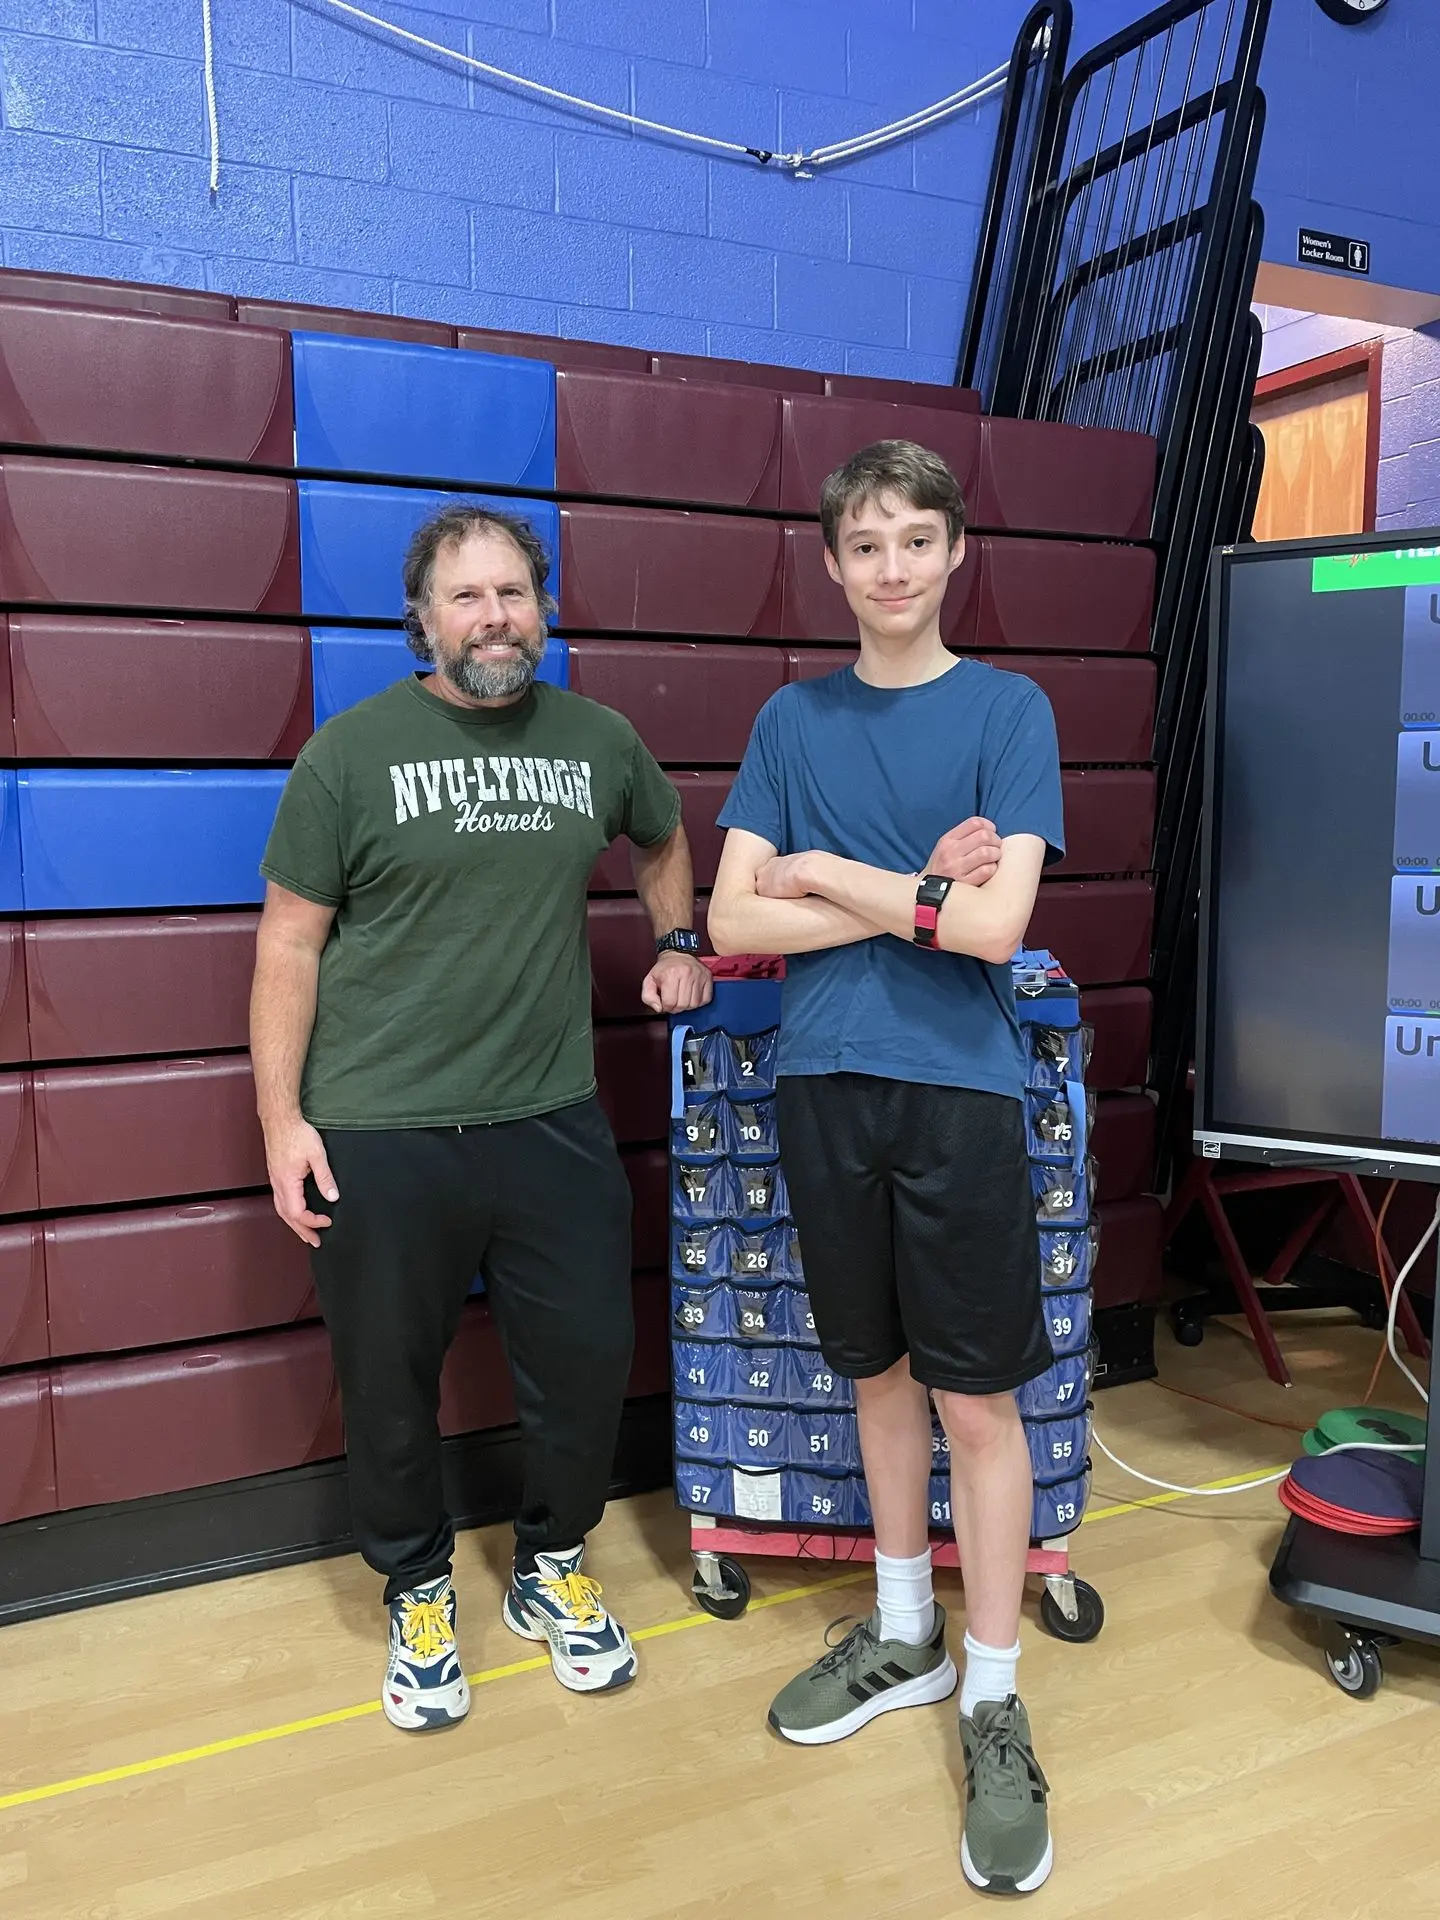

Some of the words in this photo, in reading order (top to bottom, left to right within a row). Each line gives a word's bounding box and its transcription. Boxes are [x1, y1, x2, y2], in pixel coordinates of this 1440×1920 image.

[1302, 235, 1332, 249] Women's
[1302, 247, 1324, 259] Locker
[1325, 251, 1344, 263] Room
[389, 757, 594, 825] NVU-LYNDON
[454, 801, 555, 833] Hornets
[1397, 856, 1428, 866] 00:00
[684, 1060, 694, 1076] 1
[741, 1061, 755, 1077] 2
[1055, 1056, 1070, 1073] 7
[686, 1125, 699, 1142] 9
[739, 1125, 761, 1141] 10
[1054, 1123, 1072, 1141] 15
[686, 1187, 706, 1202] 17
[746, 1188, 767, 1205] 18
[1052, 1190, 1074, 1208] 23
[685, 1249, 707, 1265] 25
[747, 1252, 768, 1269] 26
[1052, 1256, 1074, 1275] 31
[683, 1307, 705, 1324] 33
[743, 1312, 766, 1329] 34
[805, 1312, 816, 1329] 3
[1052, 1317, 1072, 1337] 39
[688, 1367, 705, 1385] 41
[749, 1370, 770, 1388] 42
[812, 1374, 833, 1393] 43
[1056, 1382, 1075, 1402] 47
[689, 1426, 709, 1443] 49
[748, 1429, 769, 1447] 50
[810, 1434, 829, 1453] 51
[932, 1436, 951, 1452] 53
[1052, 1441, 1072, 1460] 55
[691, 1485, 711, 1504] 57
[811, 1495, 832, 1515] 59
[931, 1501, 951, 1520] 61
[1056, 1502, 1075, 1523] 63
